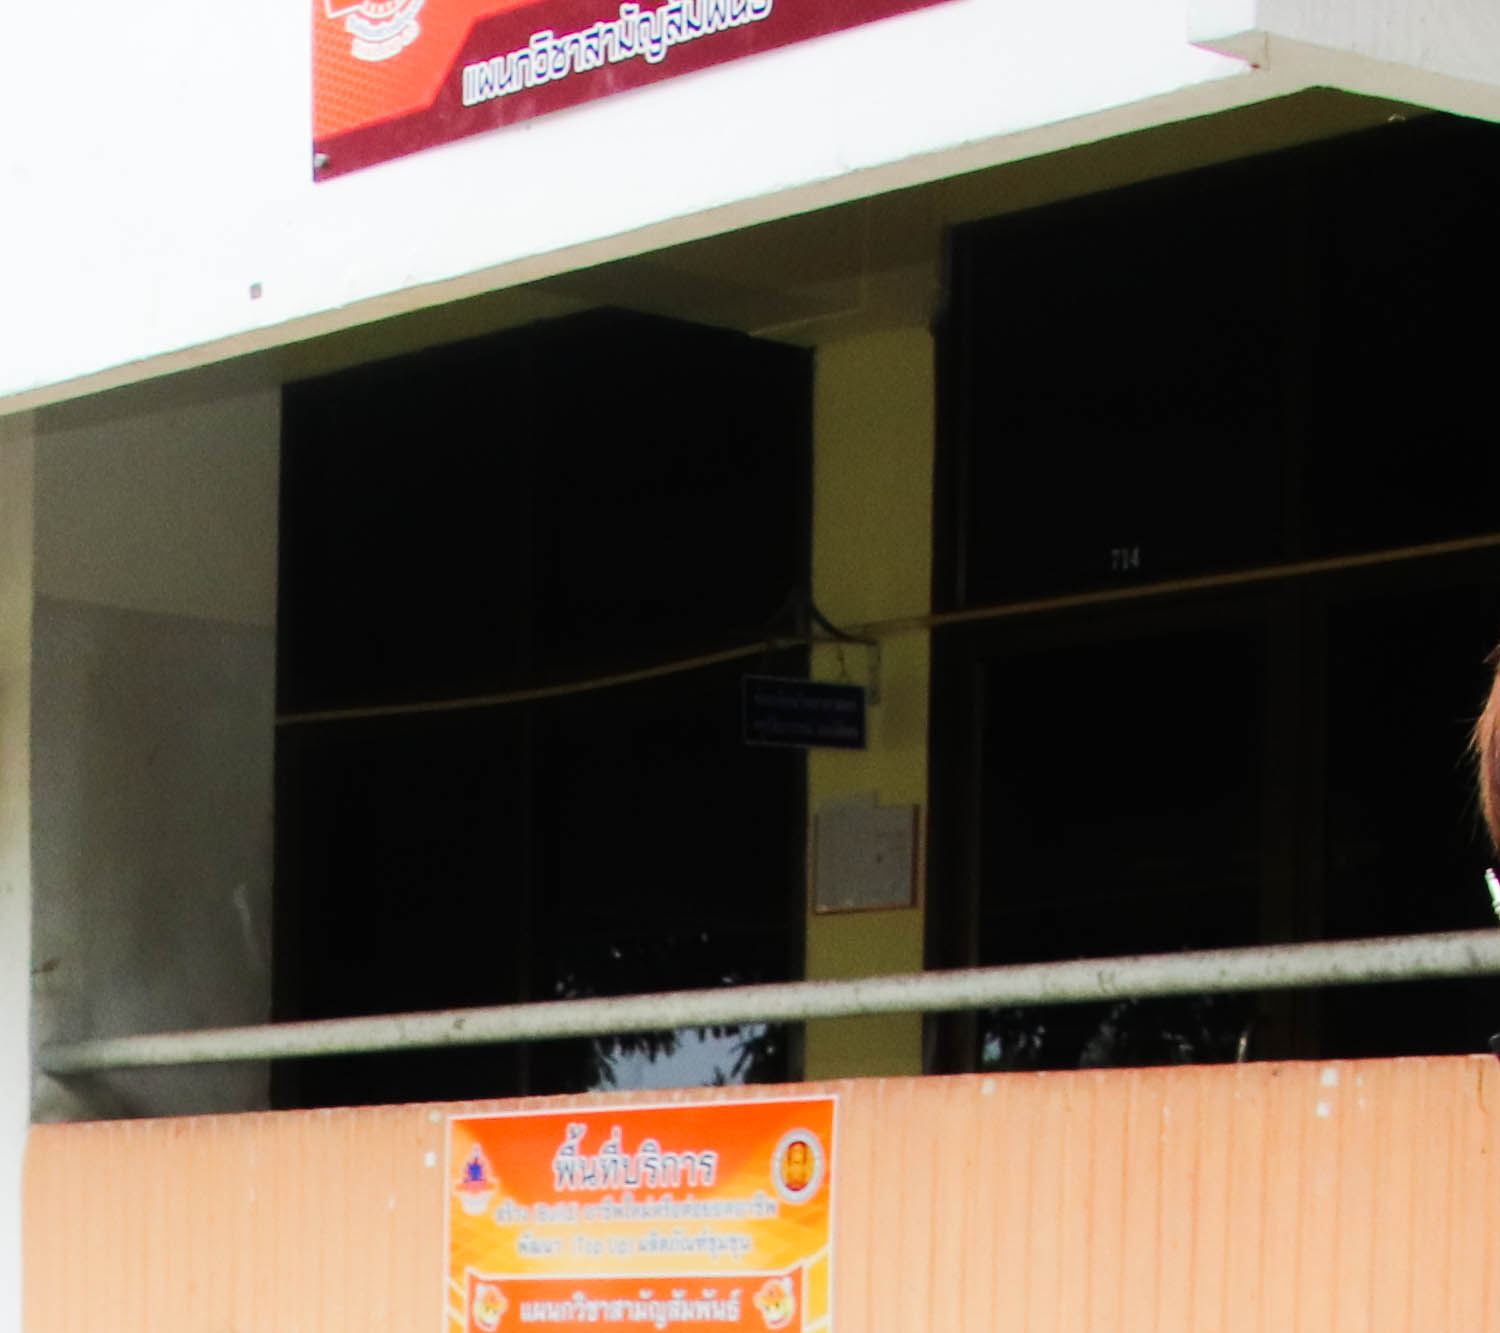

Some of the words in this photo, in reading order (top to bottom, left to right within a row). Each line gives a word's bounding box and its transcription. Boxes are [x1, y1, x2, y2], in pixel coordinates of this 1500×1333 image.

[552, 1122, 717, 1191] พื้นที่บริการ
[520, 1287, 742, 1330] แผนกวิชาสามัญสัมพันธ์
